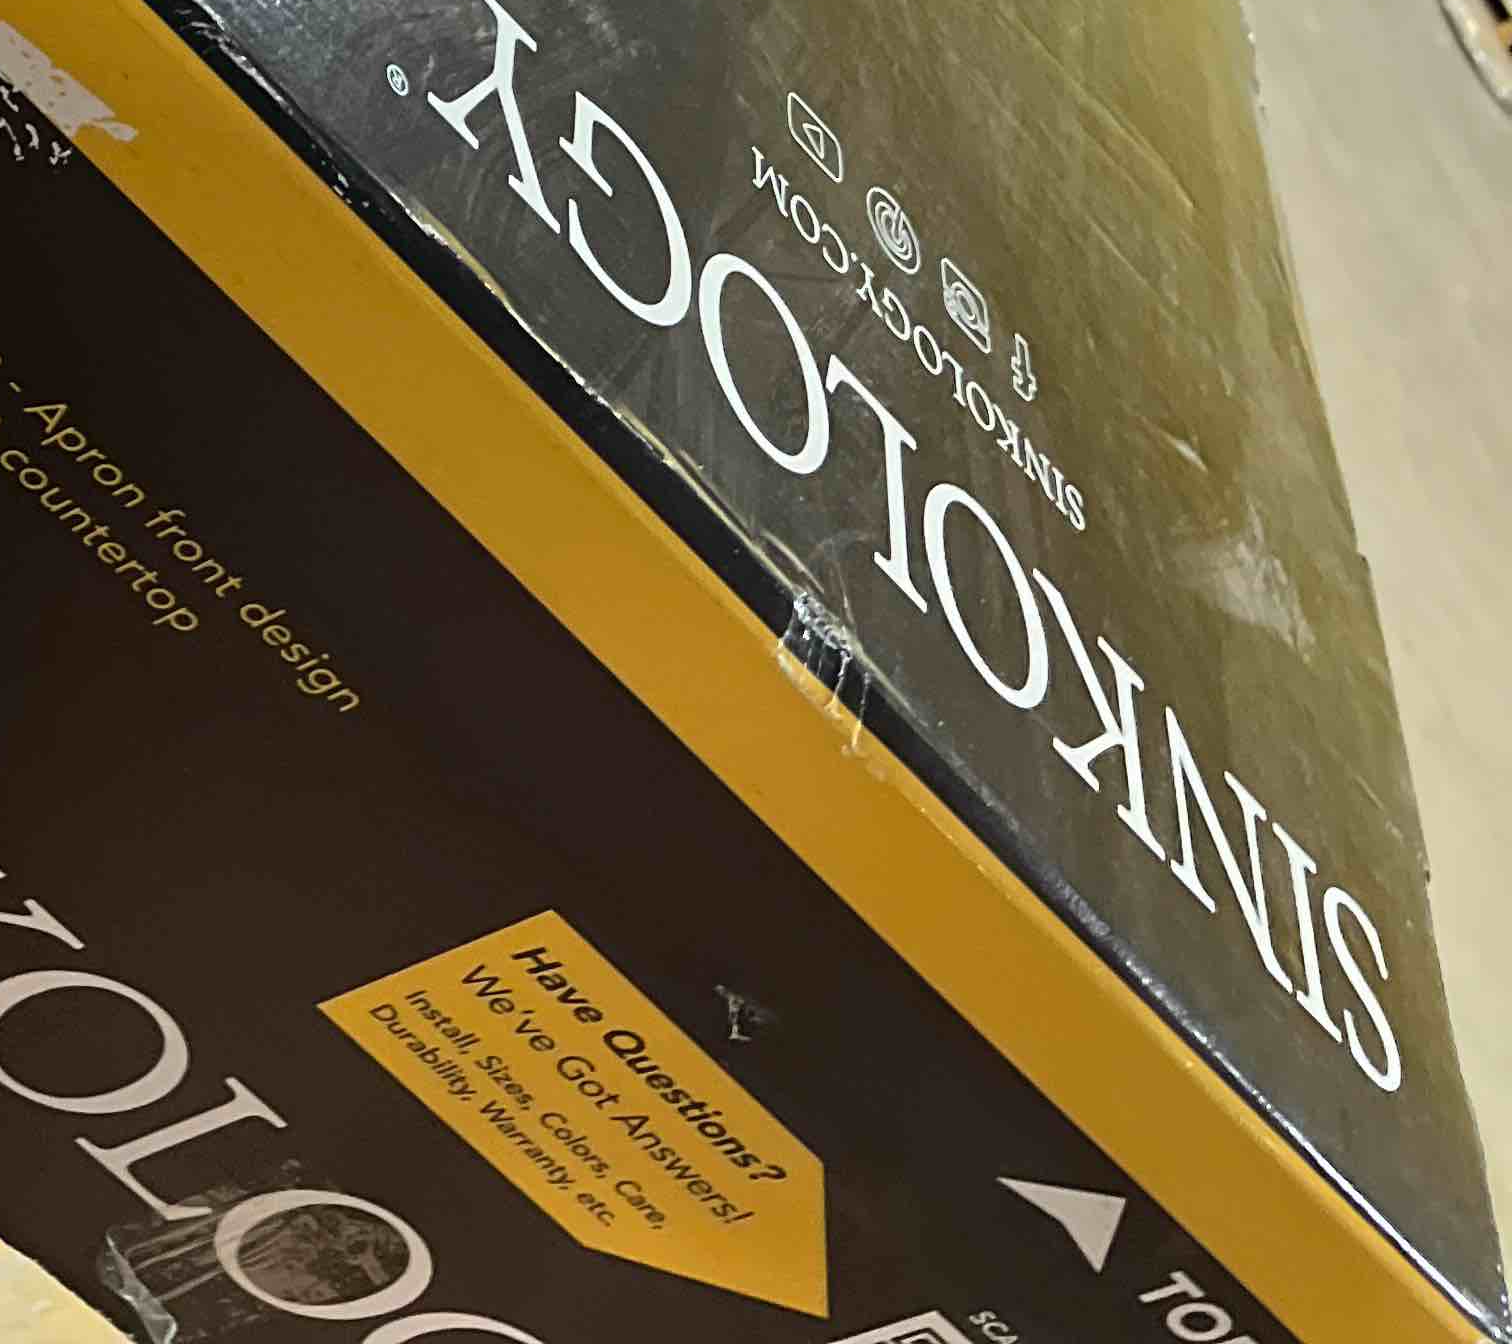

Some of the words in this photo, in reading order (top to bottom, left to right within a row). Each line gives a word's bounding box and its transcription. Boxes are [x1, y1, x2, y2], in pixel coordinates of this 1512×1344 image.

[752, 146, 1087, 532] SINKOLOGY.COM
[0, 448, 199, 635] countertop
[23, 398, 147, 510] Apron
[144, 508, 245, 601] front
[240, 600, 362, 715] design
[368, 1002, 476, 1104] Durability,
[480, 1098, 574, 1193] Warranty,
[575, 1188, 616, 1229] etc.
[403, 989, 481, 1057] Install,
[476, 1052, 534, 1113] Sizes,
[539, 1109, 612, 1181] Colors,
[614, 1178, 670, 1232] Care,
[460, 963, 555, 1052] We've
[556, 1048, 623, 1111] Got
[609, 1110, 757, 1227] Answers!
[511, 945, 607, 1029] Have
[600, 1023, 788, 1186] Questions?
